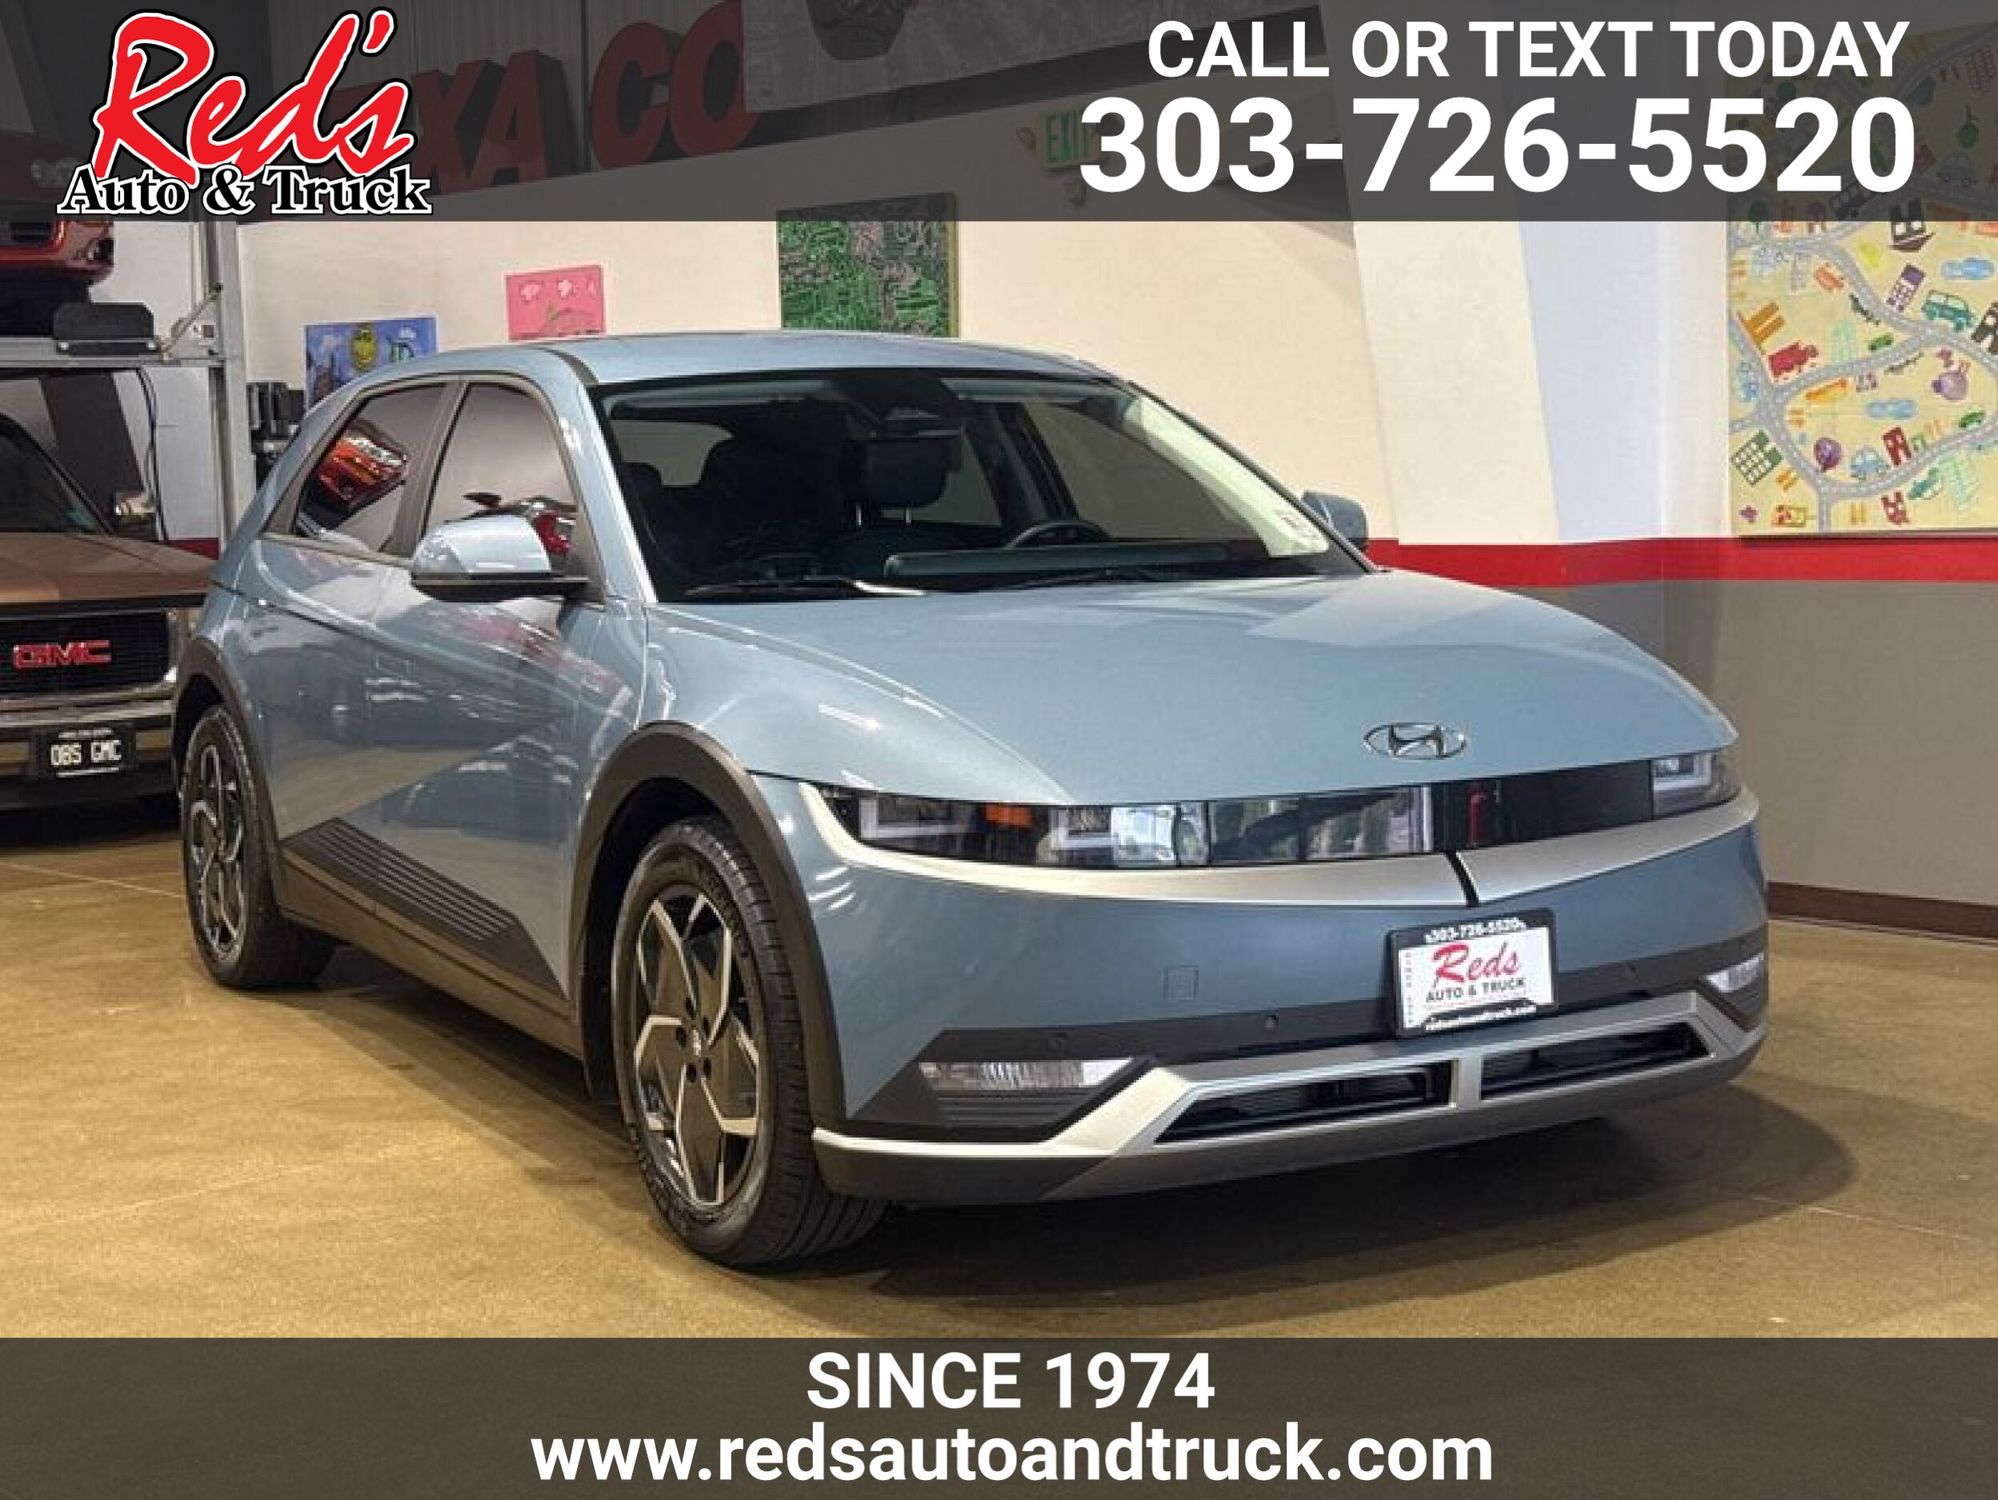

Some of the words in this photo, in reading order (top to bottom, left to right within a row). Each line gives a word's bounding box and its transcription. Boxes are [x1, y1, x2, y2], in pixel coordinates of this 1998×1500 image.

[13, 640, 112, 669] GMC
[90, 739, 122, 763] GMC
[1431, 942, 1520, 988] Reds
[1425, 986, 1463, 1003] AUTO
[1468, 985, 1477, 997] &
[1483, 977, 1525, 994] TRUCK
